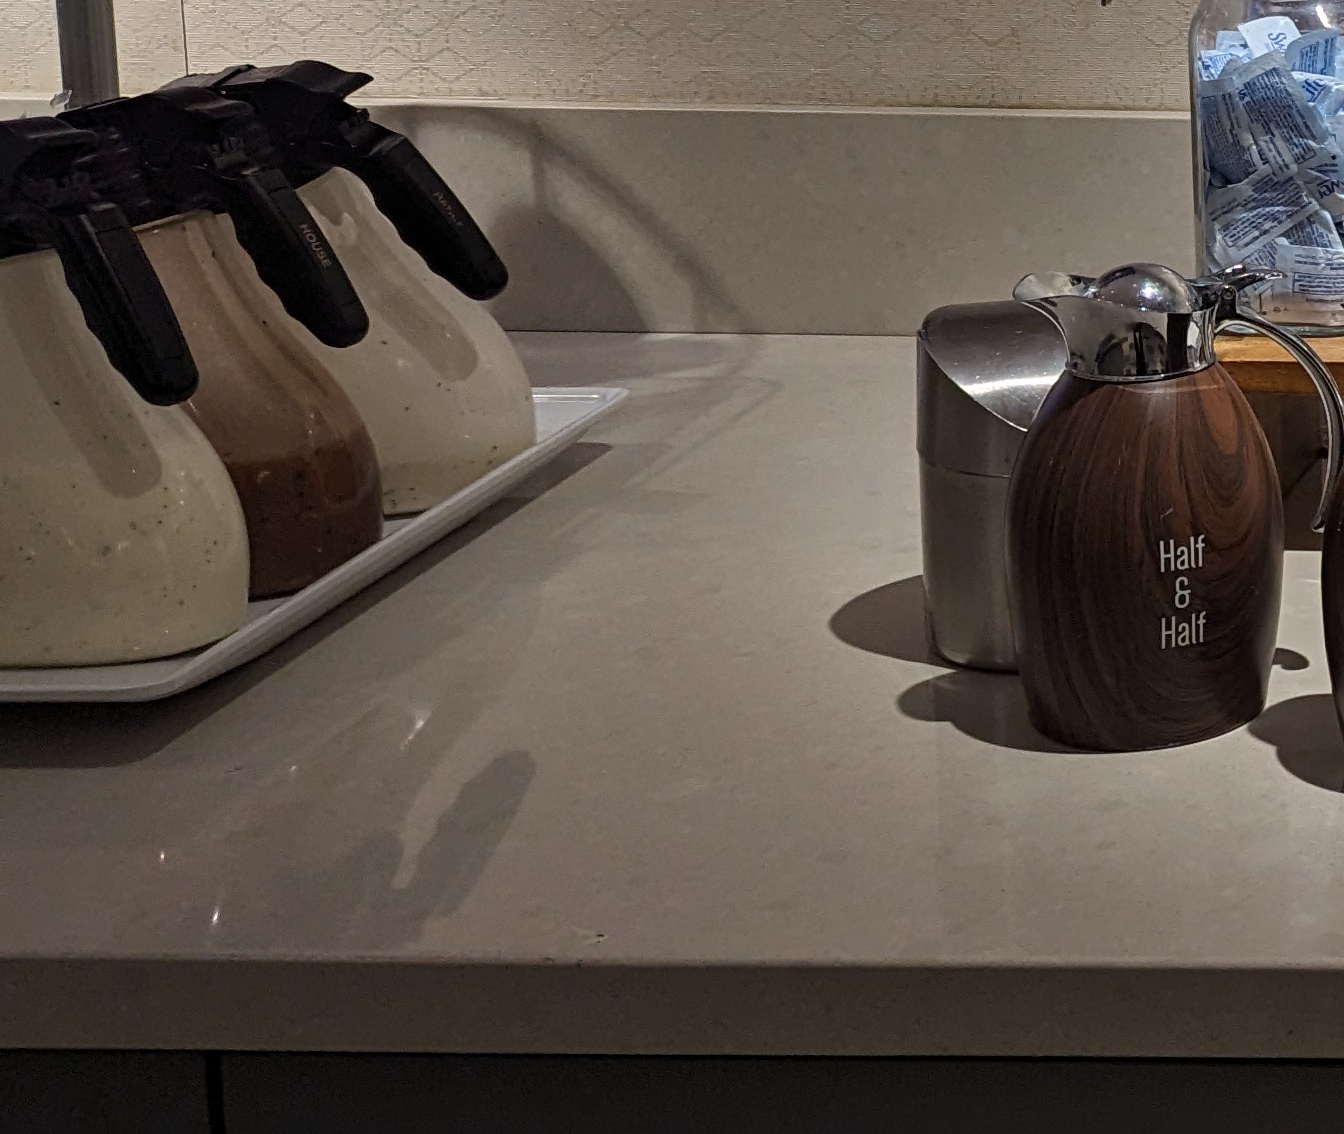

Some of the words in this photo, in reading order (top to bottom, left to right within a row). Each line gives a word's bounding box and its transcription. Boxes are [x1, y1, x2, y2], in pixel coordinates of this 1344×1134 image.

[299, 224, 333, 267] HOUSE
[1159, 534, 1206, 573] Half
[1174, 576, 1192, 609] &
[1161, 611, 1207, 650] Half
